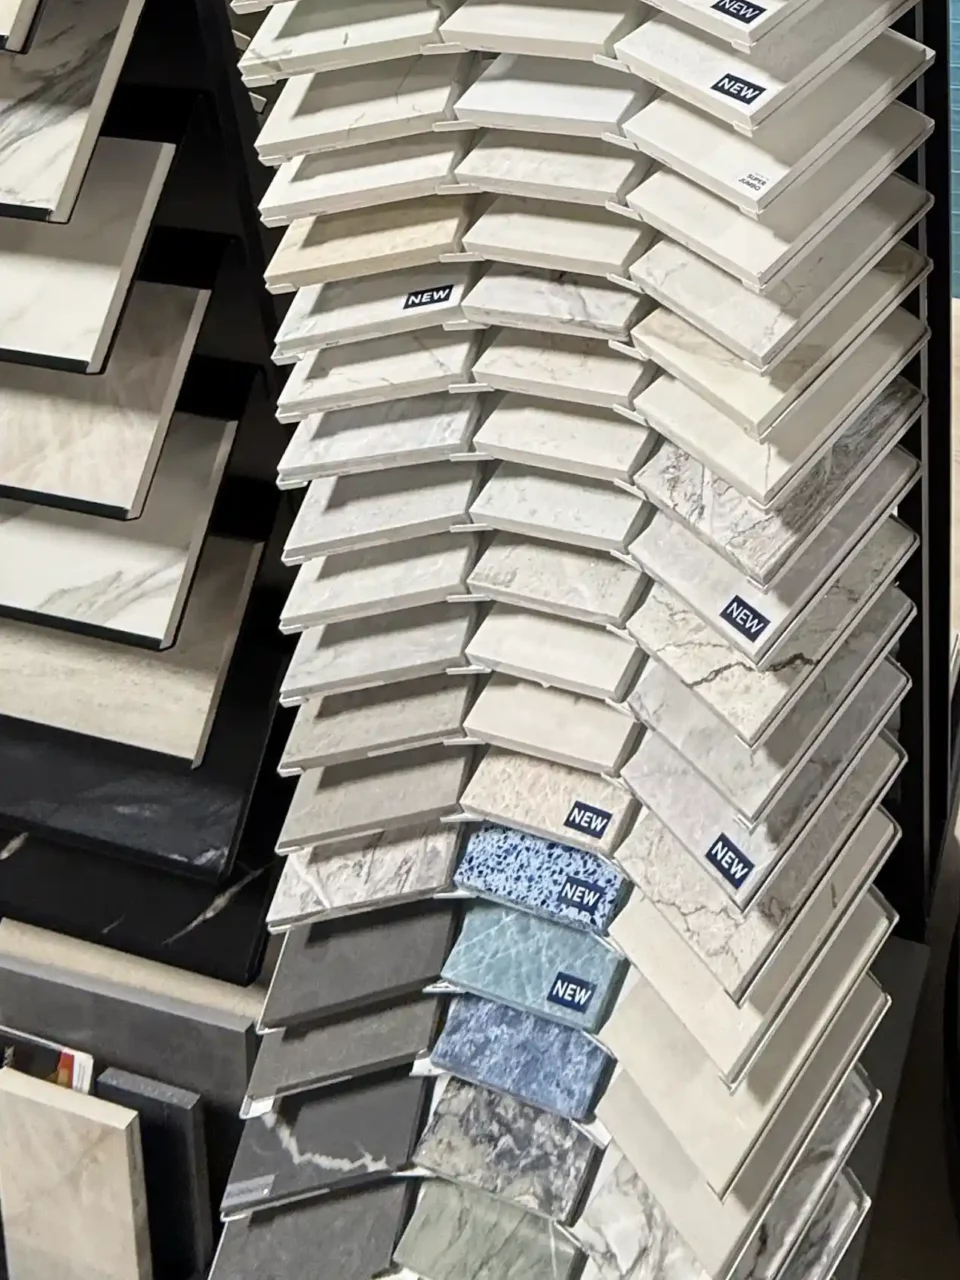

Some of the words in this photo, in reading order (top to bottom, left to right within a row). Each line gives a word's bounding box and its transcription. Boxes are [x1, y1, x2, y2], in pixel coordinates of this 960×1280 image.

[717, 77, 759, 99] NEW
[738, 177, 762, 192] JUMBO
[747, 173, 767, 187] SUPER
[408, 288, 450, 305] NEW
[725, 601, 764, 635] NEW
[568, 807, 608, 833] NEW
[711, 838, 750, 879] NEW
[561, 884, 601, 908] NEW
[552, 979, 592, 1006] NEW
